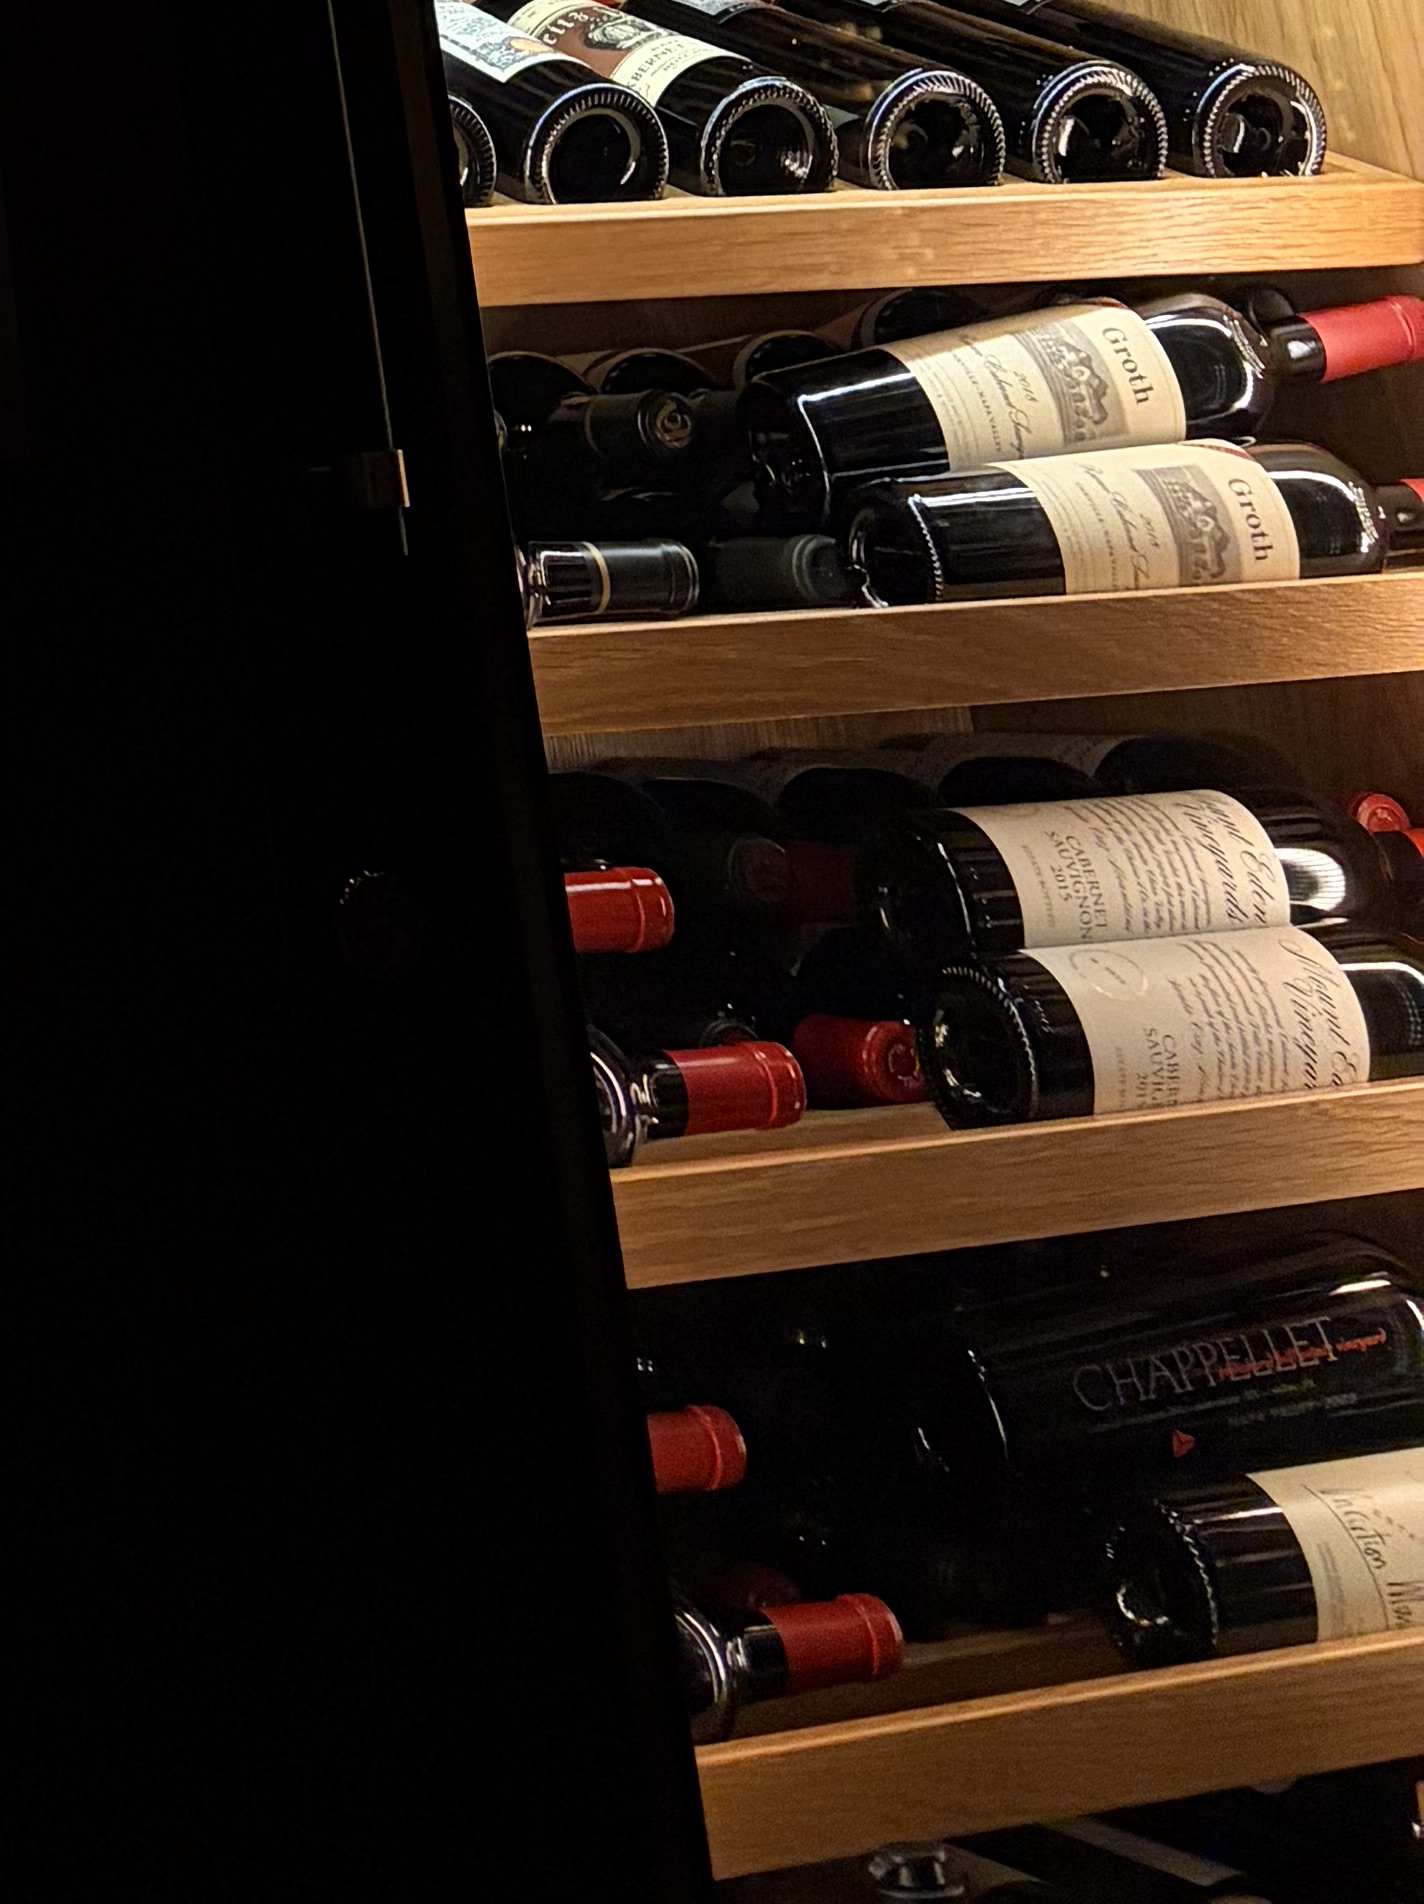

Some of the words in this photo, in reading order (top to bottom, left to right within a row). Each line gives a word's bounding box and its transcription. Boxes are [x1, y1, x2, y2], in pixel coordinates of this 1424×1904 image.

[1101, 326, 1155, 405] Groth
[1228, 477, 1274, 562] Groth
[1043, 829, 1094, 942] SAUVIGNON
[1049, 862, 1072, 902] 2015
[1064, 834, 1108, 929] CABERNET
[1277, 938, 1351, 1048] Mount
[1071, 1315, 1340, 1415] CHAPPELLET
